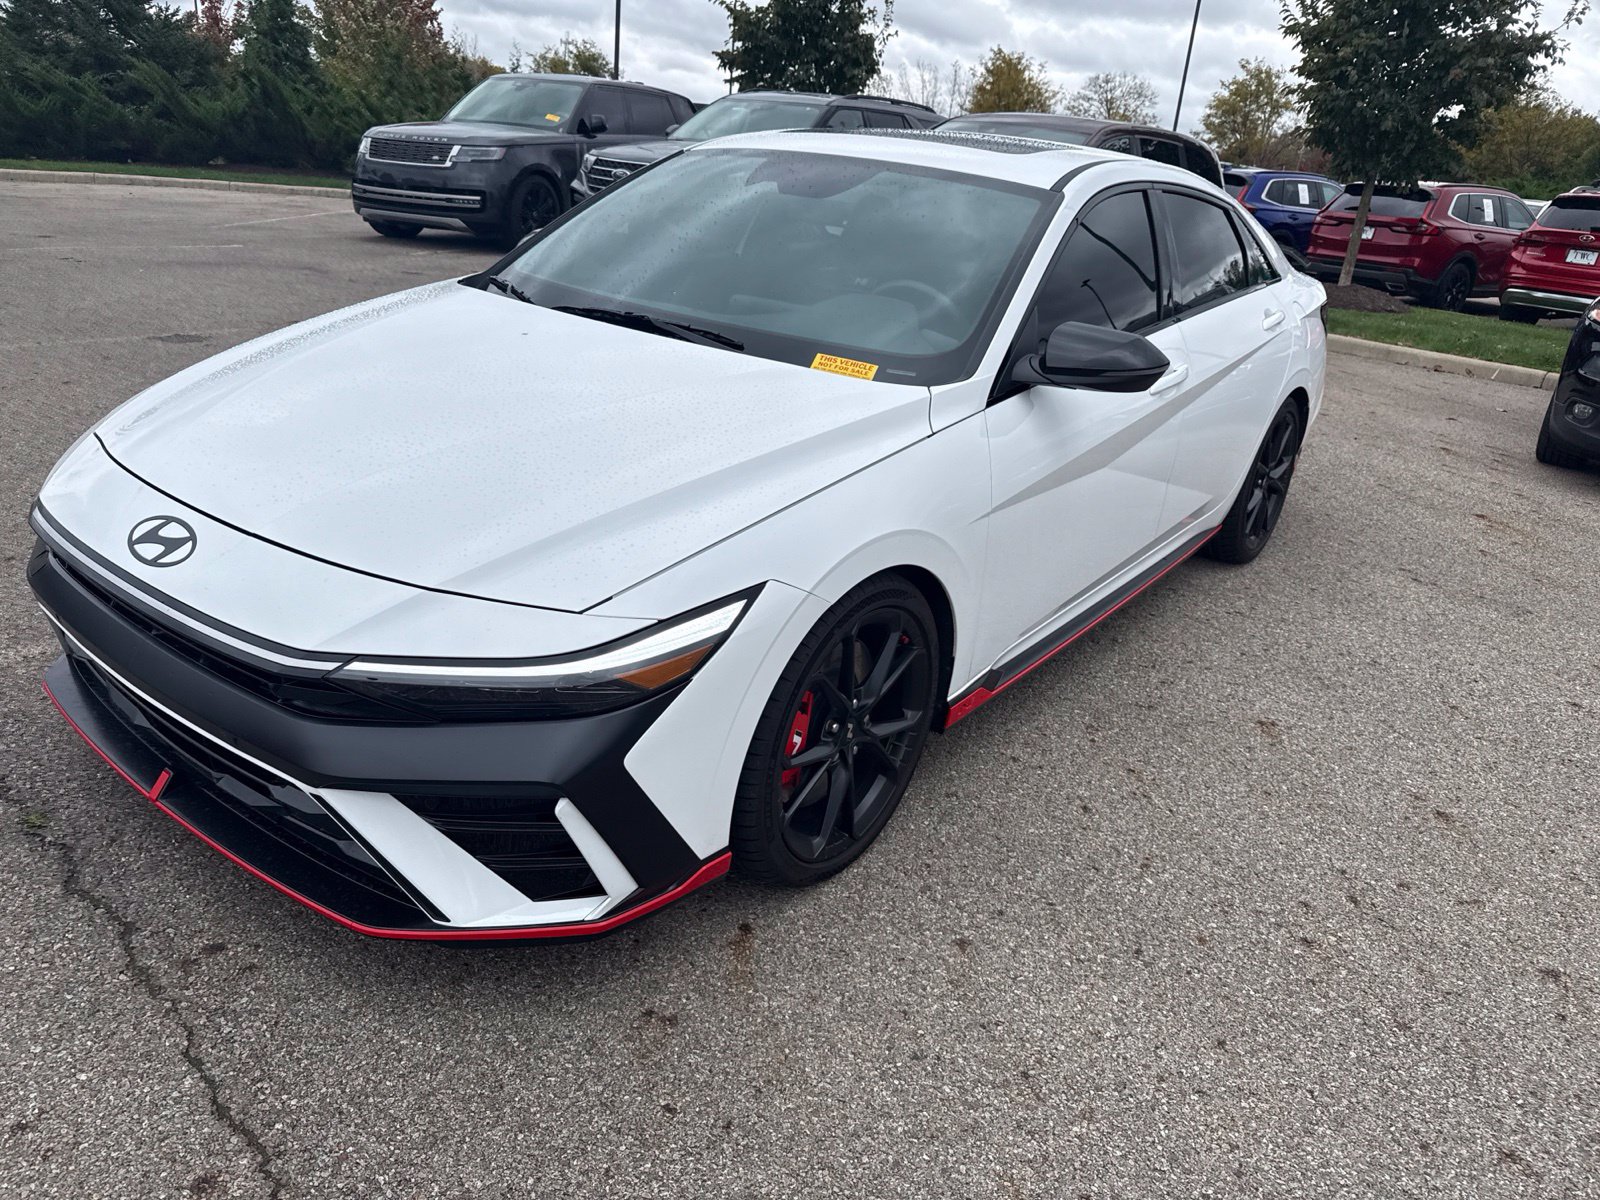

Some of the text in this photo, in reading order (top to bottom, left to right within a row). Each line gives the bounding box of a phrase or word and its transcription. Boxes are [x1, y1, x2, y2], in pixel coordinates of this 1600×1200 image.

[1574, 251, 1593, 261] TWC
[819, 355, 874, 372] THIS VEHICLE
[850, 368, 869, 377] SALE
